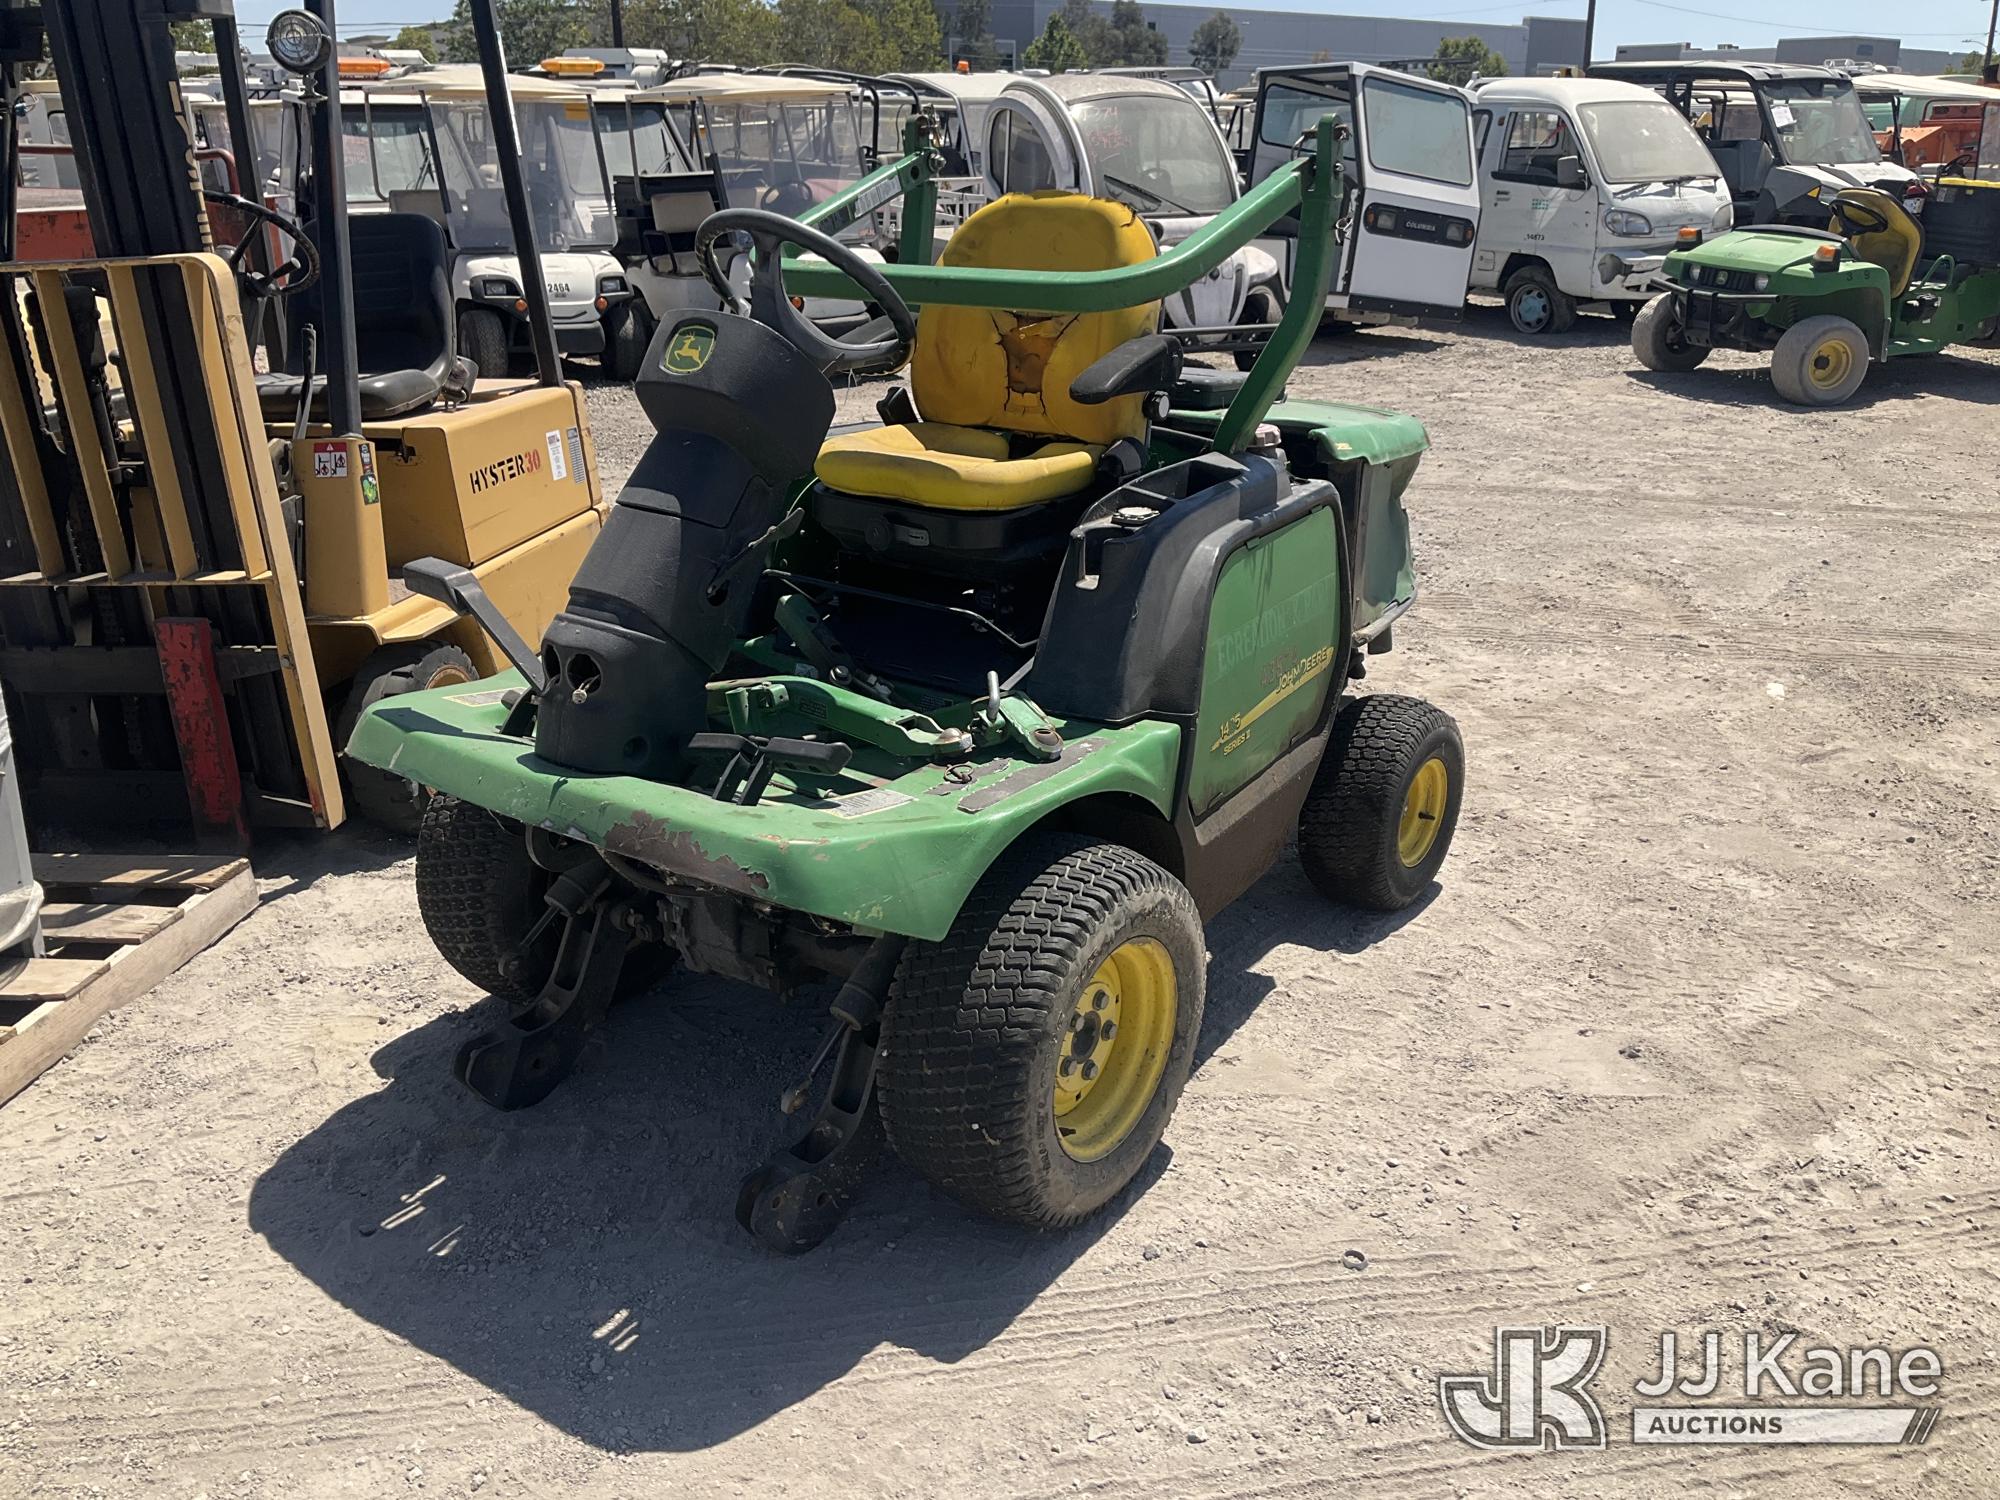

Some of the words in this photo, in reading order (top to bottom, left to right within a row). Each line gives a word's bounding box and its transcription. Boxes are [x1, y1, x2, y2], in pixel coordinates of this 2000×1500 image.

[547, 283, 570, 293] 2464
[1220, 713, 1242, 741] 145
[1223, 733, 1246, 756] SERIES
